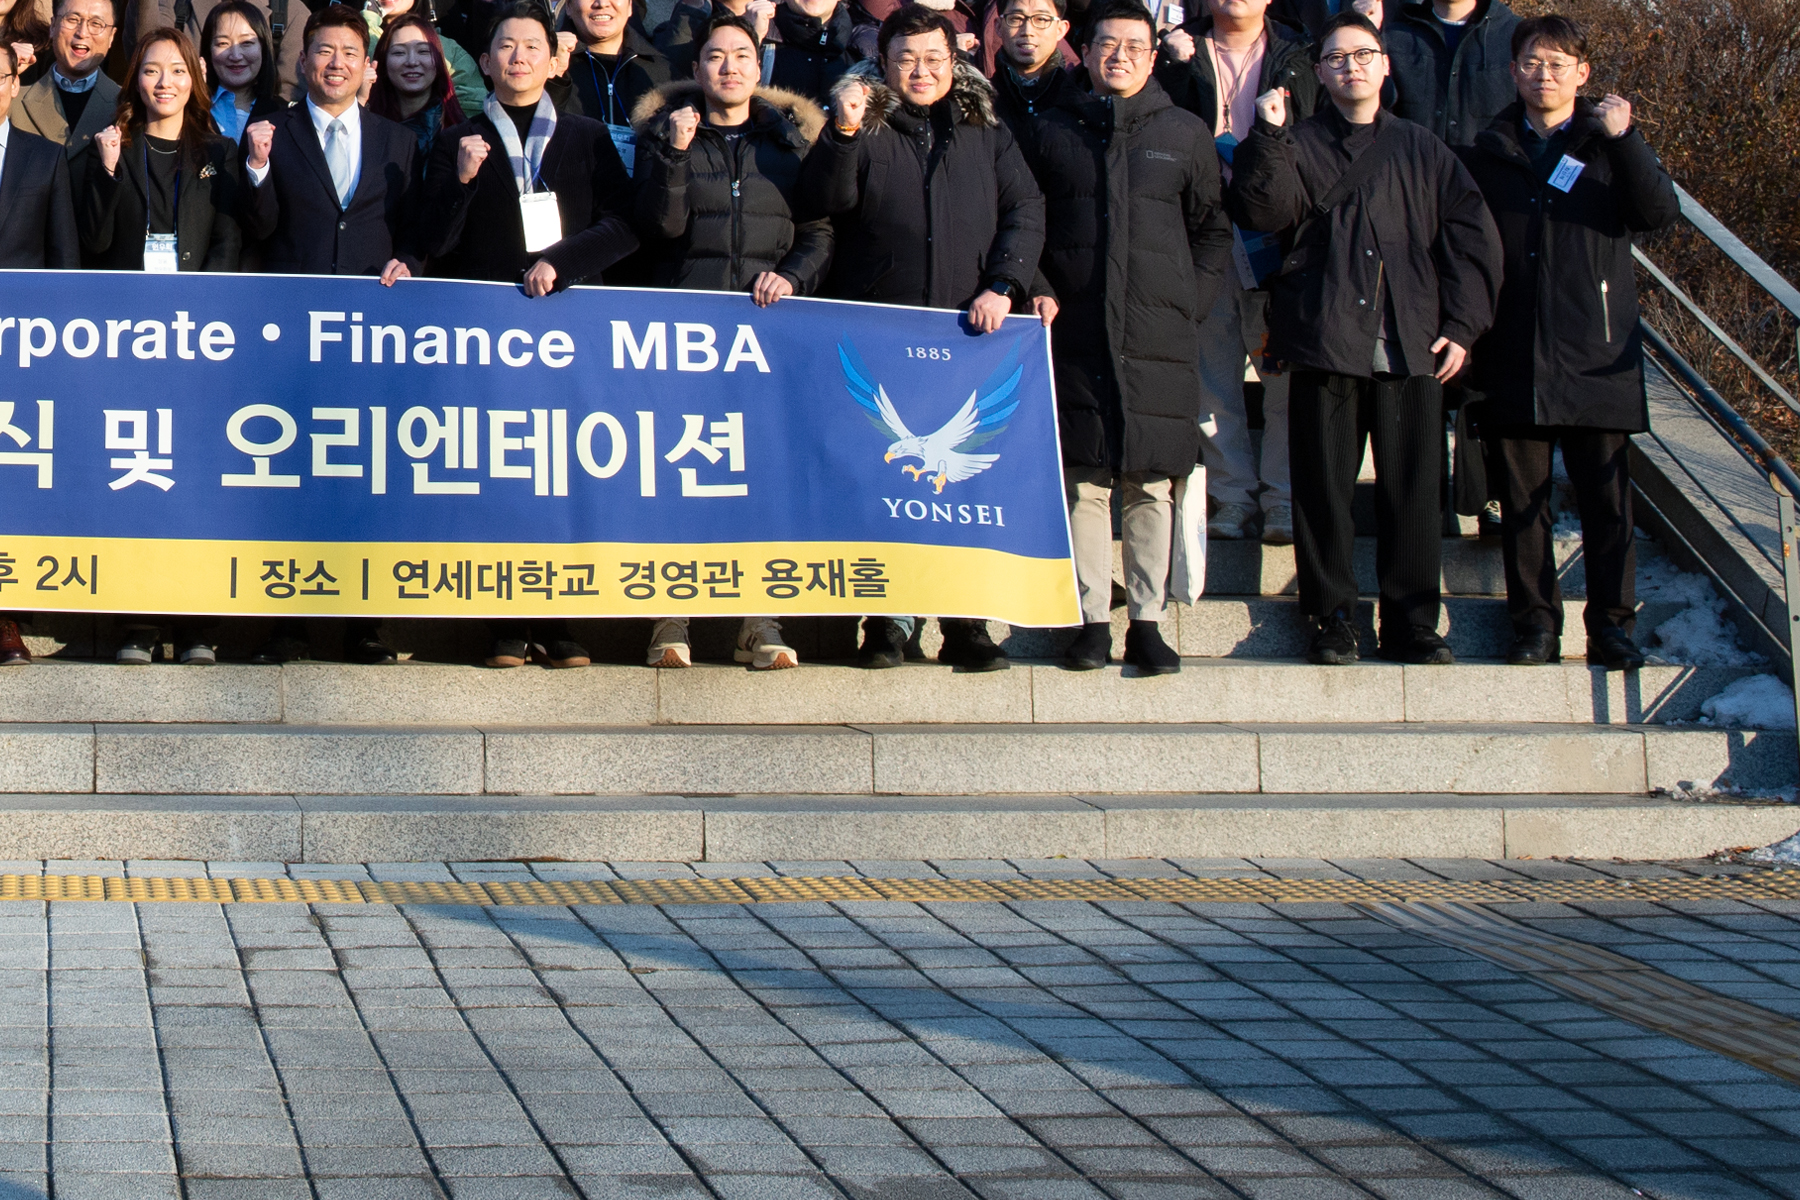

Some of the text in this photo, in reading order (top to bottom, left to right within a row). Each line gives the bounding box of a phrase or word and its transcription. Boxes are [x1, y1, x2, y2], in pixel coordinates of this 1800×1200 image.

[307, 310, 576, 369] Finance
[609, 319, 772, 374] MBA
[906, 346, 952, 361] 1885
[103, 408, 176, 492] 및
[220, 403, 749, 498] 오리엔테이션
[882, 497, 1006, 528] YONSEI
[35, 554, 98, 595] 2시
[259, 558, 341, 599] 장소
[392, 559, 600, 601] 연세대학교
[619, 559, 744, 600] 경영관
[761, 557, 890, 599] 용재홀
